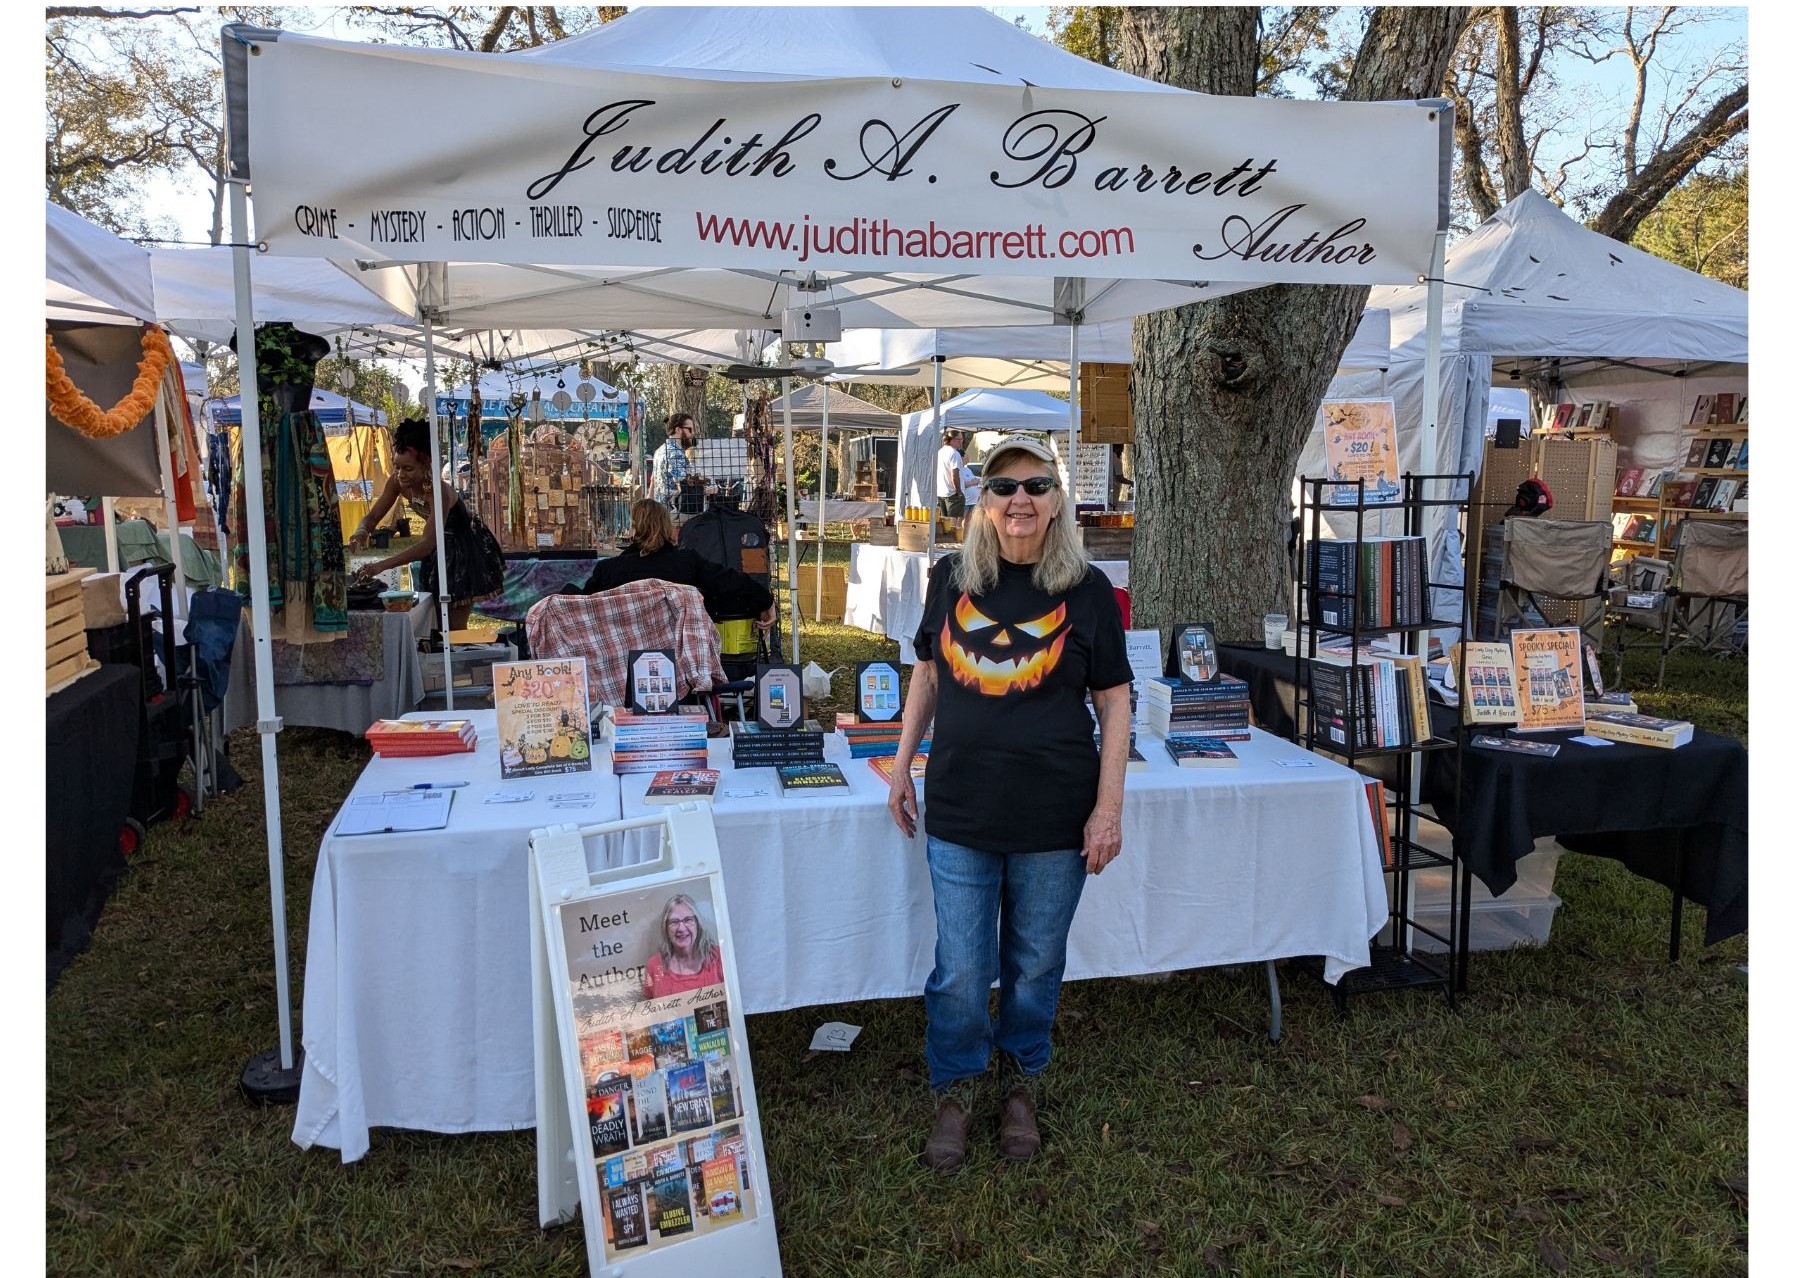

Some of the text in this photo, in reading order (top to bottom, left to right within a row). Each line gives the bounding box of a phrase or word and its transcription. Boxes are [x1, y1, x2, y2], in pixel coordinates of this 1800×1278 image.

[527, 99, 1277, 202] Judith A. Barrett
[295, 204, 339, 239] CRIME
[371, 208, 427, 243] MYSTERY
[453, 207, 506, 240] ACTION
[530, 205, 584, 238] THRILLER
[607, 207, 663, 243] SUSPENSE
[696, 211, 1134, 261] www.judithabarrett.com
[1193, 203, 1377, 266] Author
[1519, 641, 1575, 651] SPOOKY SPECIAL!
[509, 661, 572, 680] Any Book!
[1532, 704, 1549, 715] $75
[579, 909, 630, 933] Meet
[592, 940, 623, 959] the
[577, 964, 645, 991] Author
[579, 1012, 615, 1033] Judith
[687, 988, 726, 1006] Author
[598, 1081, 630, 1097] DANGER
[591, 1118, 625, 1135] DEADLY
[592, 1130, 626, 1145] WRATH
[615, 1193, 639, 1208] ALWAYS
[614, 1204, 639, 1219] WANTED
[662, 1207, 685, 1220] ELUSIVE
[623, 1222, 635, 1234] SPY
